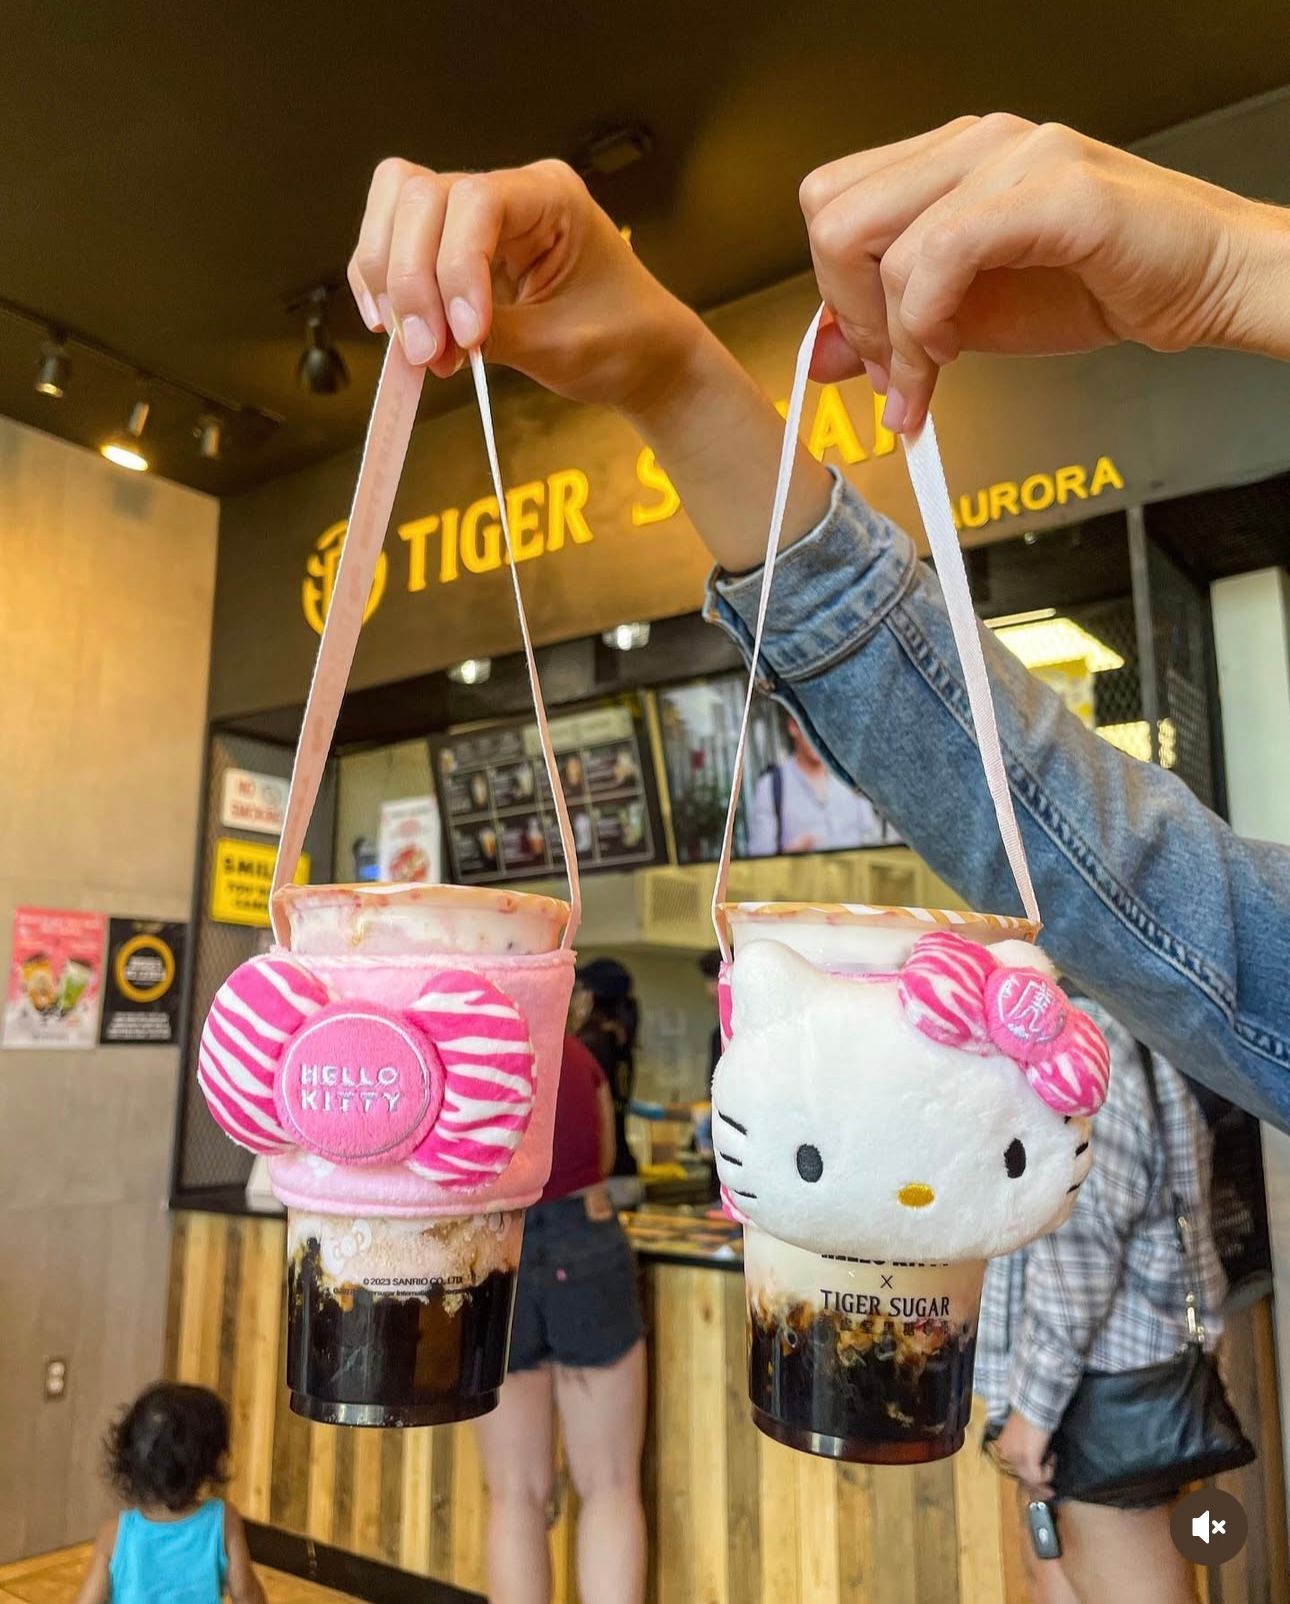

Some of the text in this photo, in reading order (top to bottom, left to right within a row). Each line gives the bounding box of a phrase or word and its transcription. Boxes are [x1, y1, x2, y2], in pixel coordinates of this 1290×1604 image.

[950, 456, 1124, 529] URORA
[397, 468, 595, 593] TIGER
[224, 857, 271, 879] SMIL
[301, 1063, 398, 1087] HELLO
[301, 1089, 399, 1112] KITTY
[370, 1277, 390, 1286] 2023
[391, 1276, 429, 1286] SANRIO
[820, 1289, 950, 1318] TIGER SUGAR
